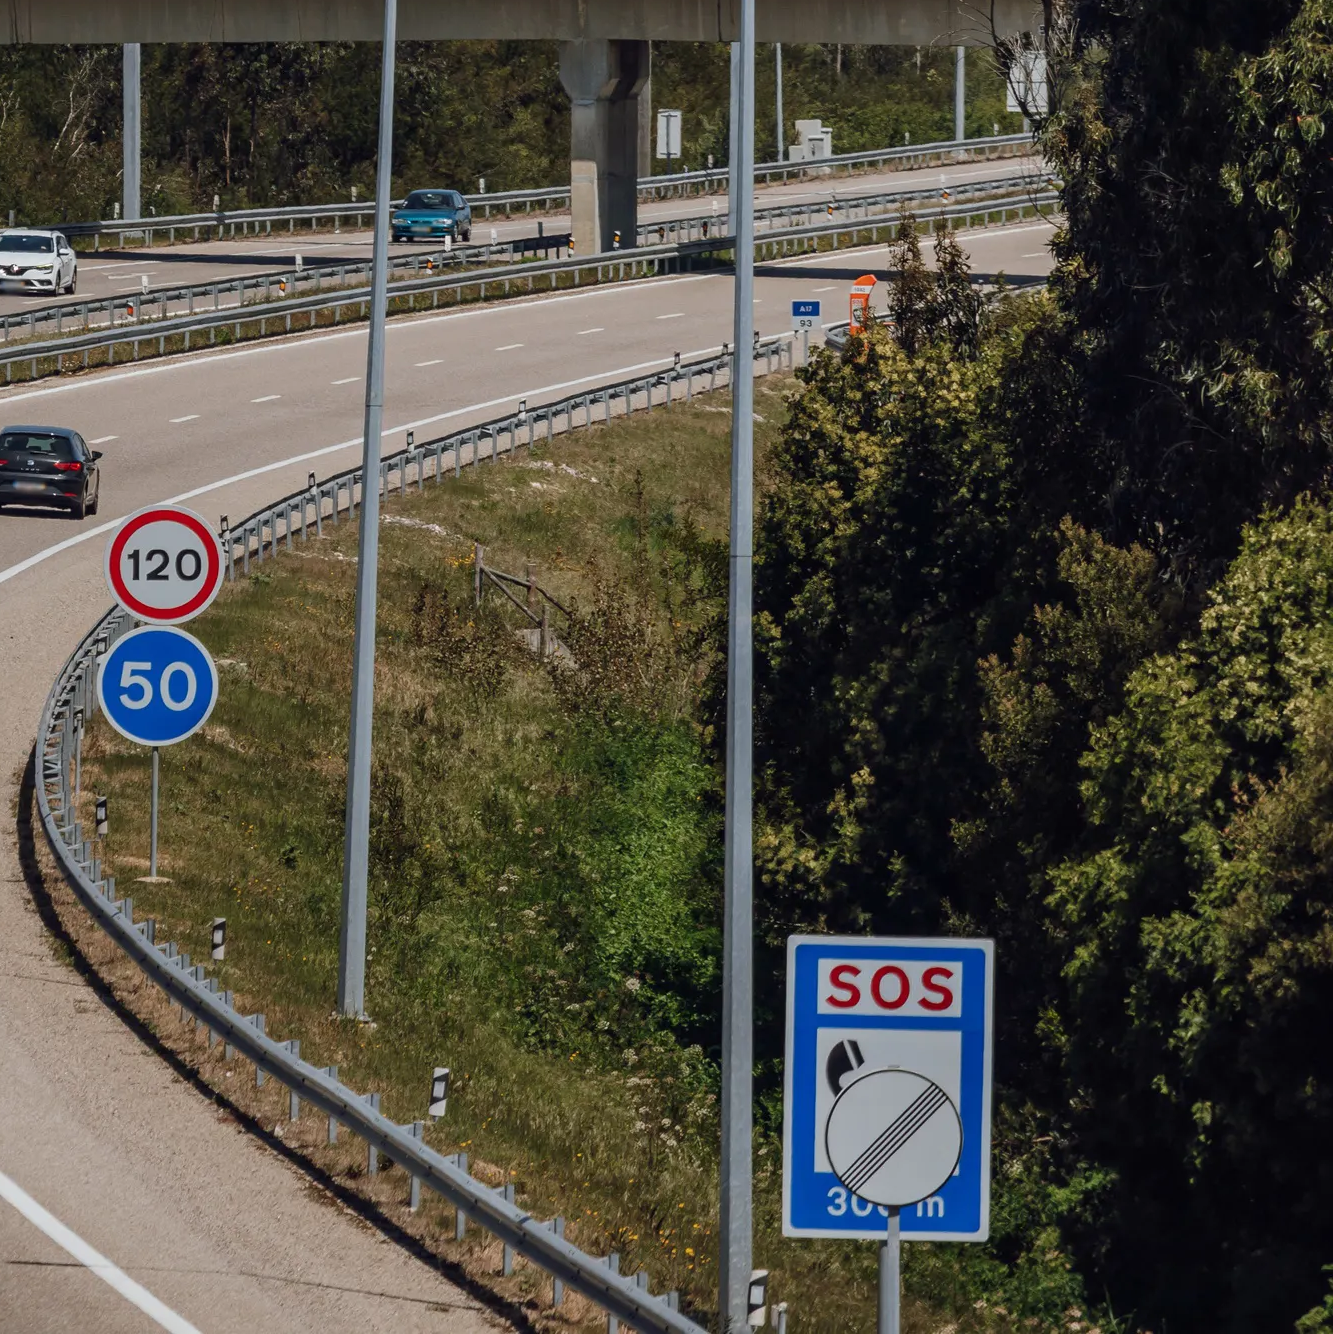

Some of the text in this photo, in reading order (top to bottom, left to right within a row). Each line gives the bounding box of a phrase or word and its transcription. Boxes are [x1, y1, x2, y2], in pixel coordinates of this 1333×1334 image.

[799, 319, 812, 327] 93
[127, 549, 202, 581] 120
[119, 661, 197, 712] 50
[826, 964, 953, 1011] SOS
[827, 1186, 944, 1217] 30 m
